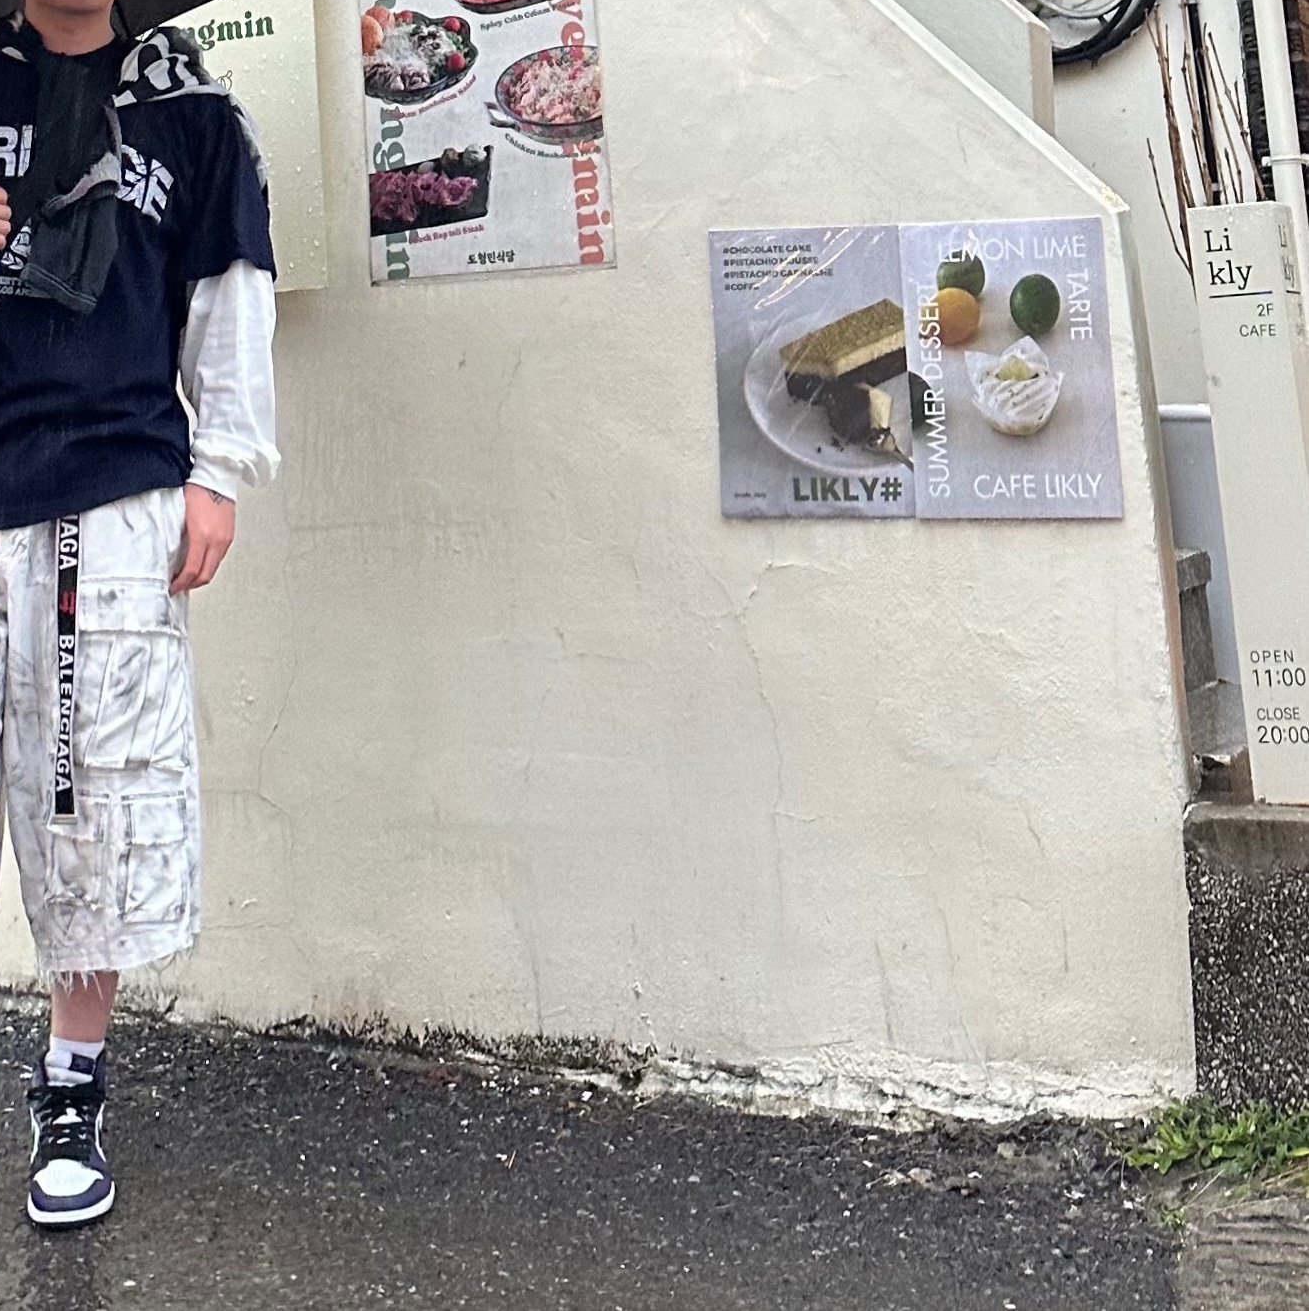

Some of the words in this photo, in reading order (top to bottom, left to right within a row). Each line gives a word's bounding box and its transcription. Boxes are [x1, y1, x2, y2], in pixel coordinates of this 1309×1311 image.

[723, 244, 785, 254] #CHOCOLATE
[785, 243, 812, 252] CAKE
[937, 238, 1025, 263] LEMON
[1033, 234, 1086, 259] LIME
[1203, 227, 1233, 253] Li
[467, 249, 516, 266] 도형민식당
[1207, 259, 1253, 291] kly
[1067, 267, 1093, 340] TARTE
[1256, 302, 1274, 317] 2F
[917, 282, 944, 387] DESSERT
[1239, 323, 1277, 337] CAFE
[924, 388, 951, 498] SUMMER
[793, 476, 903, 502] LIKLY#
[973, 473, 1037, 499] CAFE
[1044, 473, 1103, 499] LIKLY
[1250, 649, 1295, 663] OPEN
[1252, 667, 1307, 688] 11:00
[54, 634, 75, 792] BALENCIAGA
[1256, 707, 1301, 721] CLOSE
[1257, 725, 1309, 745] 20:00
